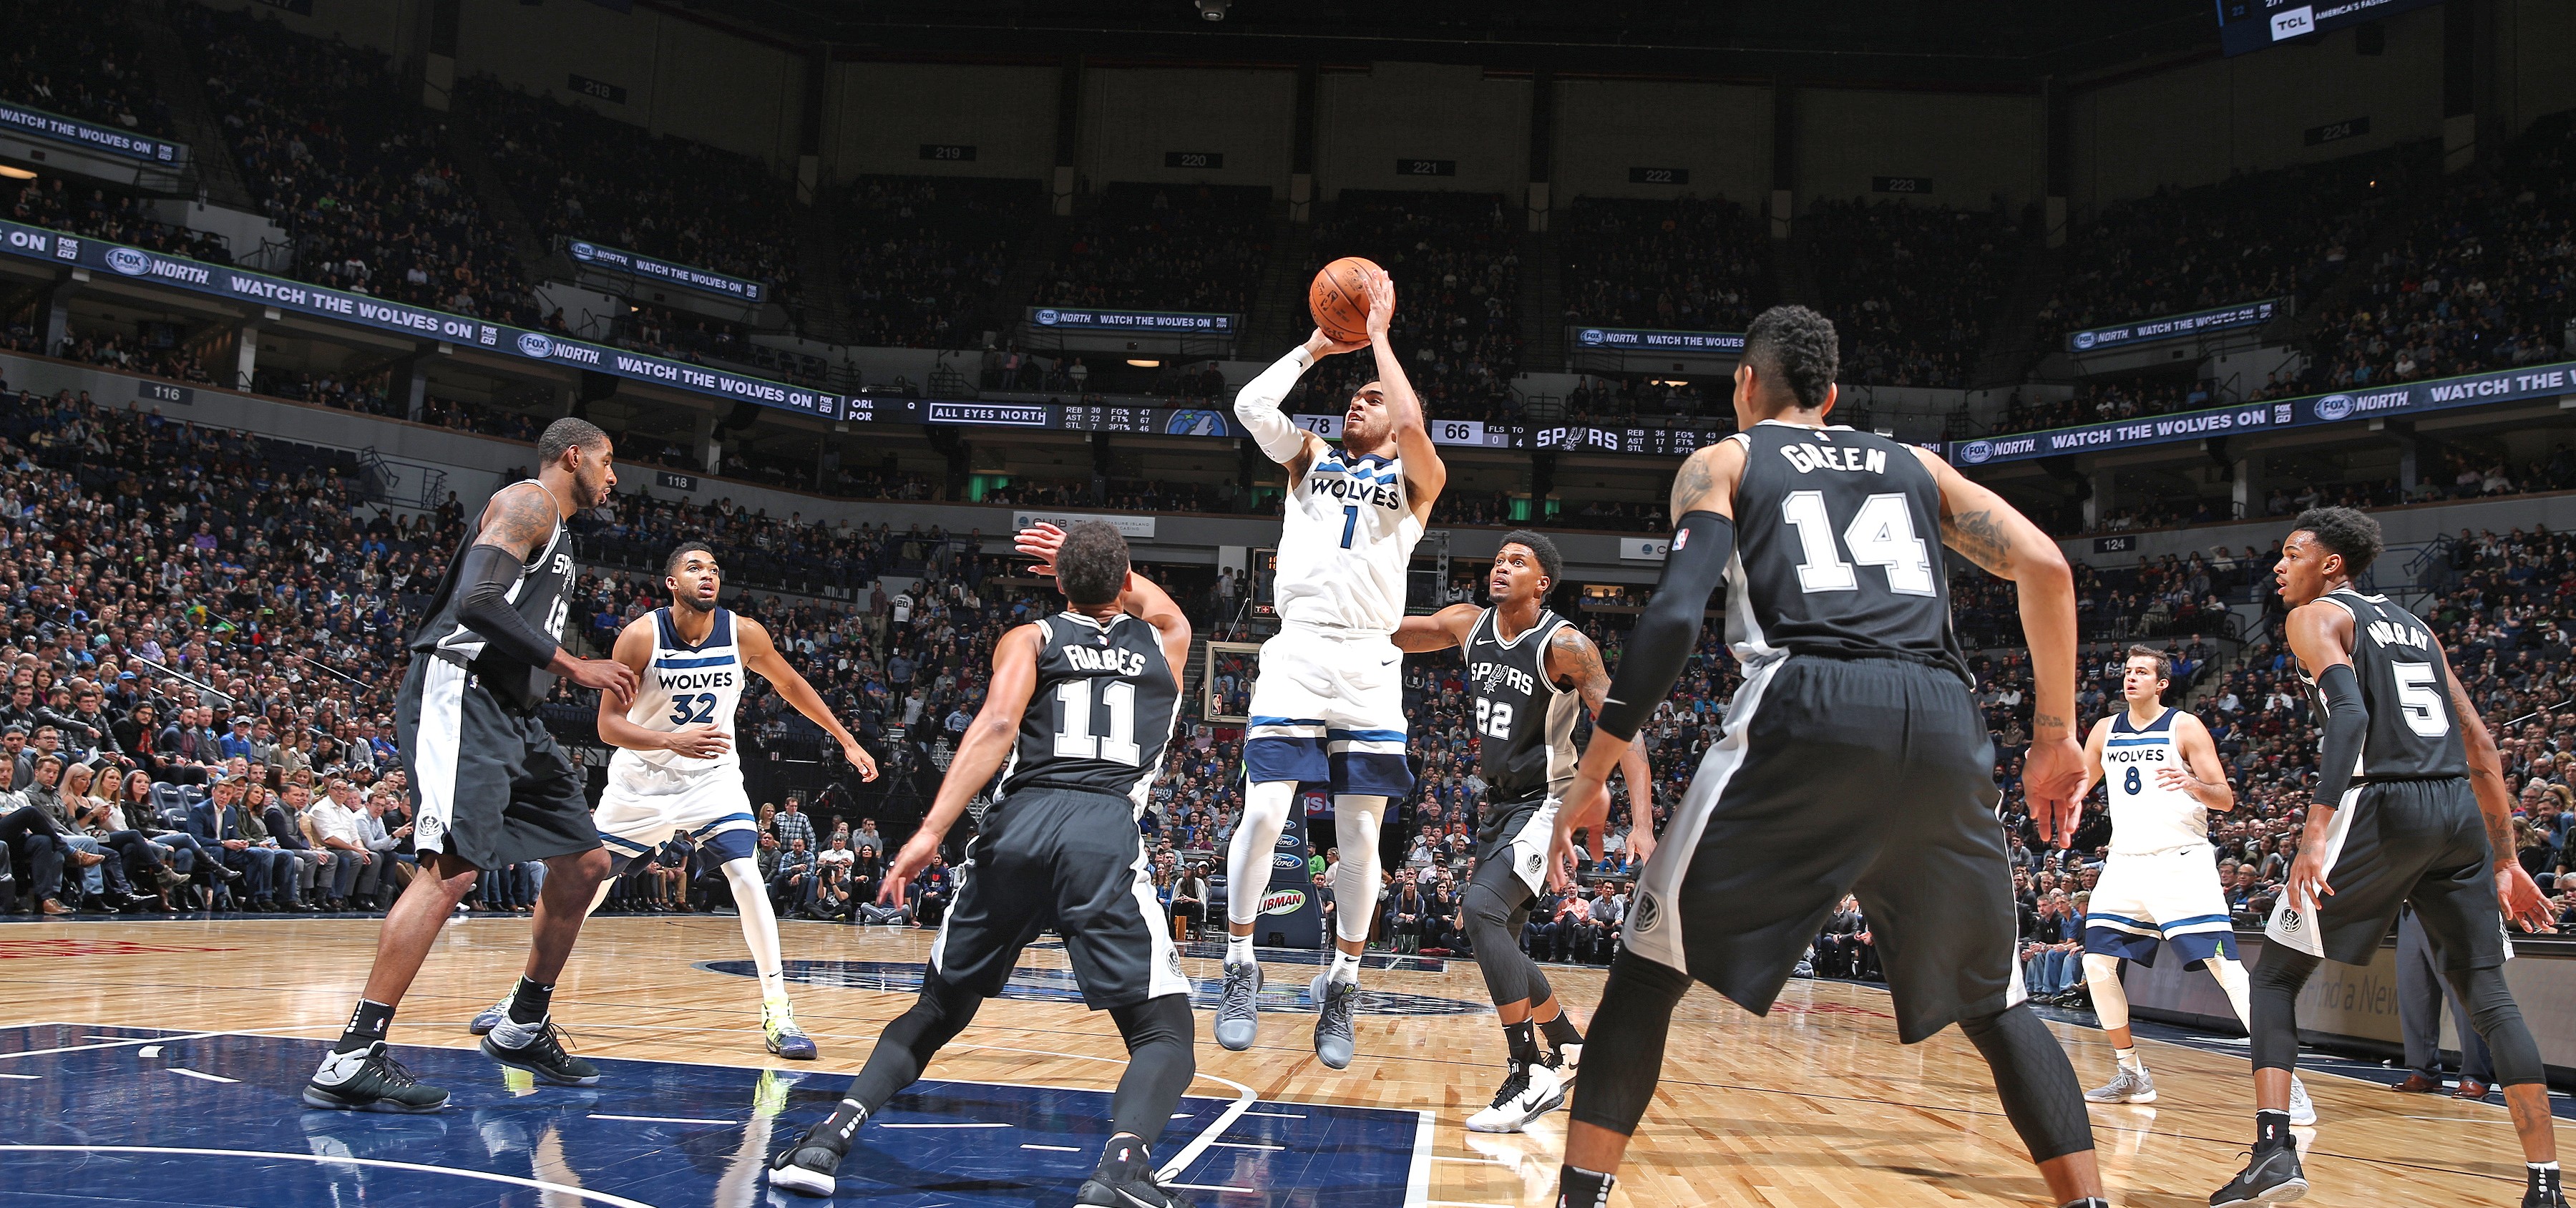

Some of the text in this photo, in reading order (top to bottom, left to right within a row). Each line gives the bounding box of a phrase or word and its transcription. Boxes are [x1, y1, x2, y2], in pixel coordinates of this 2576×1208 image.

[2278, 16, 2307, 31] TCL
[585, 81, 610, 97] 218
[0, 109, 151, 154] WATCH THE WOLVES ON
[2323, 122, 2351, 140] 224
[935, 146, 960, 159] 219
[1181, 154, 1206, 167] 220
[1413, 161, 1437, 174] 221
[1646, 170, 1672, 182] 222
[1889, 179, 1915, 192] 223
[10, 232, 46, 251] ON
[59, 237, 79, 248] FOX
[57, 250, 77, 260] GO
[577, 245, 591, 254] FOX
[117, 255, 142, 267] FOX
[597, 250, 628, 266] NORTH
[152, 260, 209, 284] NORTH
[636, 260, 742, 293] WATCH THE WOLVES ON
[232, 276, 473, 339] WATCH THE WOLVES ON
[1060, 313, 1091, 323] NORTH
[1101, 315, 1133, 324] WATCH
[1136, 316, 1153, 325] THE
[1157, 317, 1194, 327] WOLVES
[1197, 318, 1211, 327] ON
[482, 325, 497, 336] FOX
[2137, 323, 2172, 336] WATCH
[2174, 318, 2193, 331] THE
[481, 336, 496, 346] GO
[1606, 333, 1637, 343] NORTH
[1647, 336, 1745, 347] WATCH THE WOLVES
[2098, 329, 2129, 343] NORTH
[525, 338, 545, 350] FOX
[554, 343, 600, 365] NORTH
[618, 356, 812, 408] WATCH THE WOLVES ON
[2431, 378, 2509, 403] WATCH
[2516, 371, 2563, 391] THE
[154, 386, 180, 400] 116
[819, 395, 833, 405] FOX
[852, 399, 874, 409] ORL
[2275, 404, 2290, 414] FOX
[2323, 398, 2346, 410] FOX
[2356, 391, 2410, 412] NORTH
[819, 405, 832, 414] GO
[849, 411, 872, 421] POR
[935, 409, 1046, 421] ALL EYES NORTH
[1307, 417, 1330, 434] 78
[2275, 415, 2290, 424] GO
[1445, 424, 1470, 439] 66
[2051, 409, 2265, 449] WATCH THE WOLVES ON
[1492, 435, 1523, 447] 0 4
[1536, 427, 1618, 451] SPURS
[1969, 442, 1986, 455] FOX
[1994, 439, 2035, 457] NORTH
[1780, 442, 1887, 475] GREEN
[668, 476, 687, 487] 118
[1312, 478, 1400, 510] WOLVES
[1340, 505, 1358, 550] 1
[1781, 490, 1937, 598] 14
[2104, 539, 2124, 550] 124
[544, 593, 569, 643] 12
[2366, 619, 2429, 652] MURRAY
[1063, 644, 1146, 677] FORBES
[658, 671, 733, 690] WOLVES
[1471, 662, 1534, 696] SPURS
[2391, 659, 2451, 737] 5
[669, 693, 717, 726] 32
[1053, 677, 1141, 768] 11
[1475, 696, 1514, 741] 22
[2107, 749, 2165, 763] WOLVES
[2124, 766, 2142, 795] 8
[1277, 836, 1294, 846] Ford
[1274, 856, 1295, 867] Ford
[1257, 894, 1302, 913] LIBMAN
[2344, 983, 2356, 1011] a
